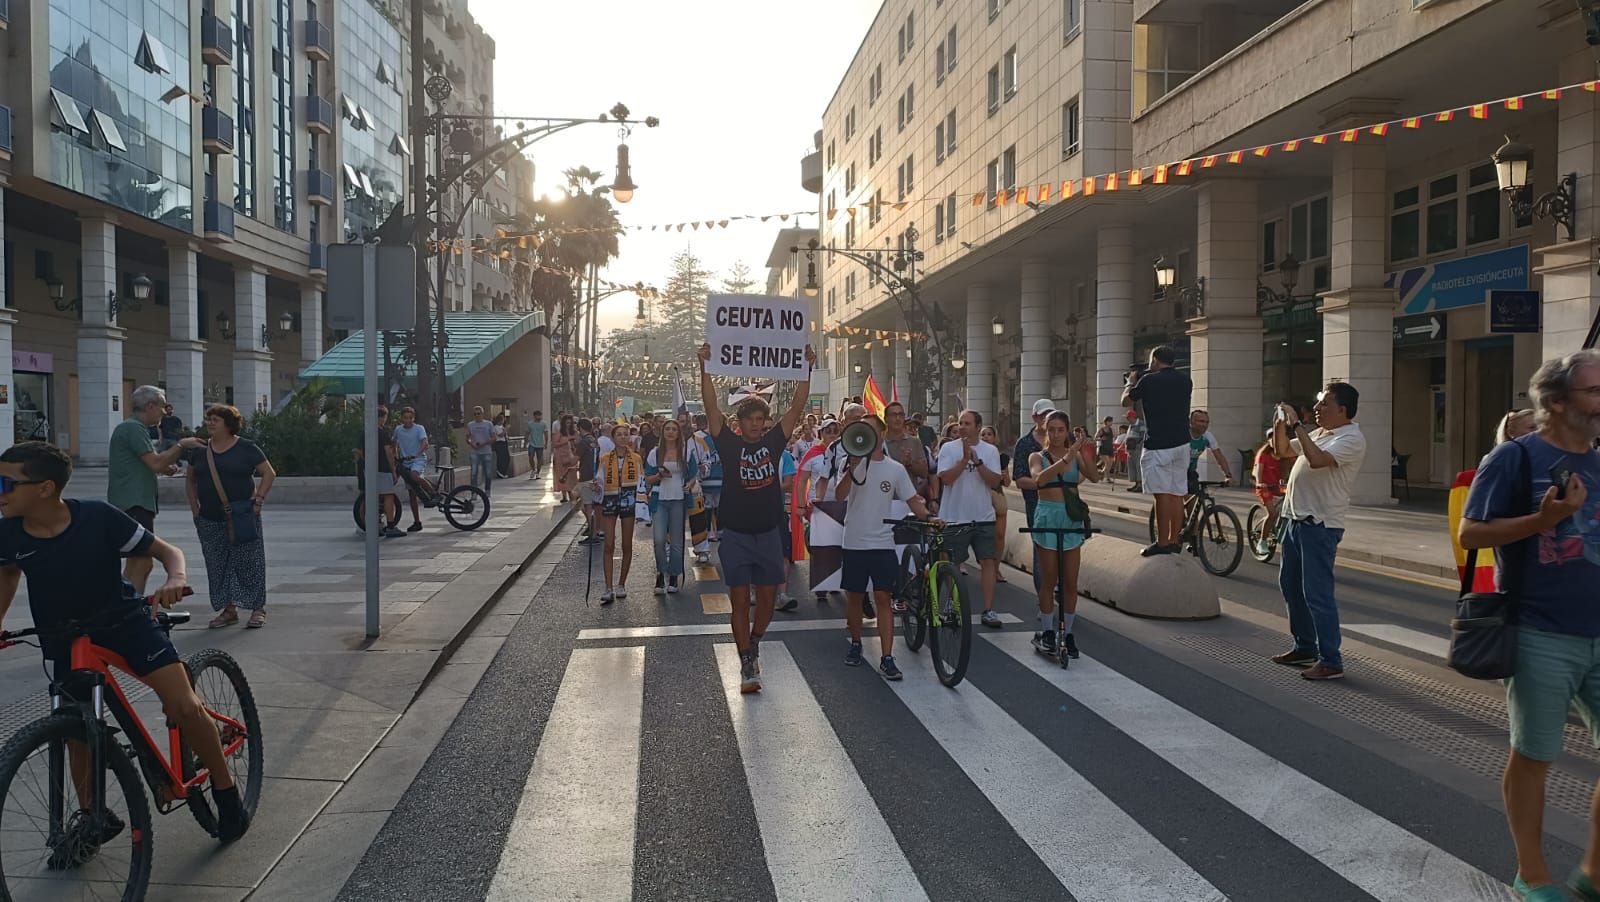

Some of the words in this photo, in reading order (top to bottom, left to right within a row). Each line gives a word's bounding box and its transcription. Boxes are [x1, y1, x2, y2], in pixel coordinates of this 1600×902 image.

[716, 306, 774, 329] CEUTA
[780, 309, 804, 331] NO
[720, 344, 744, 366] SE
[748, 346, 803, 369] RINDE
[740, 462, 774, 480] CEUTA
